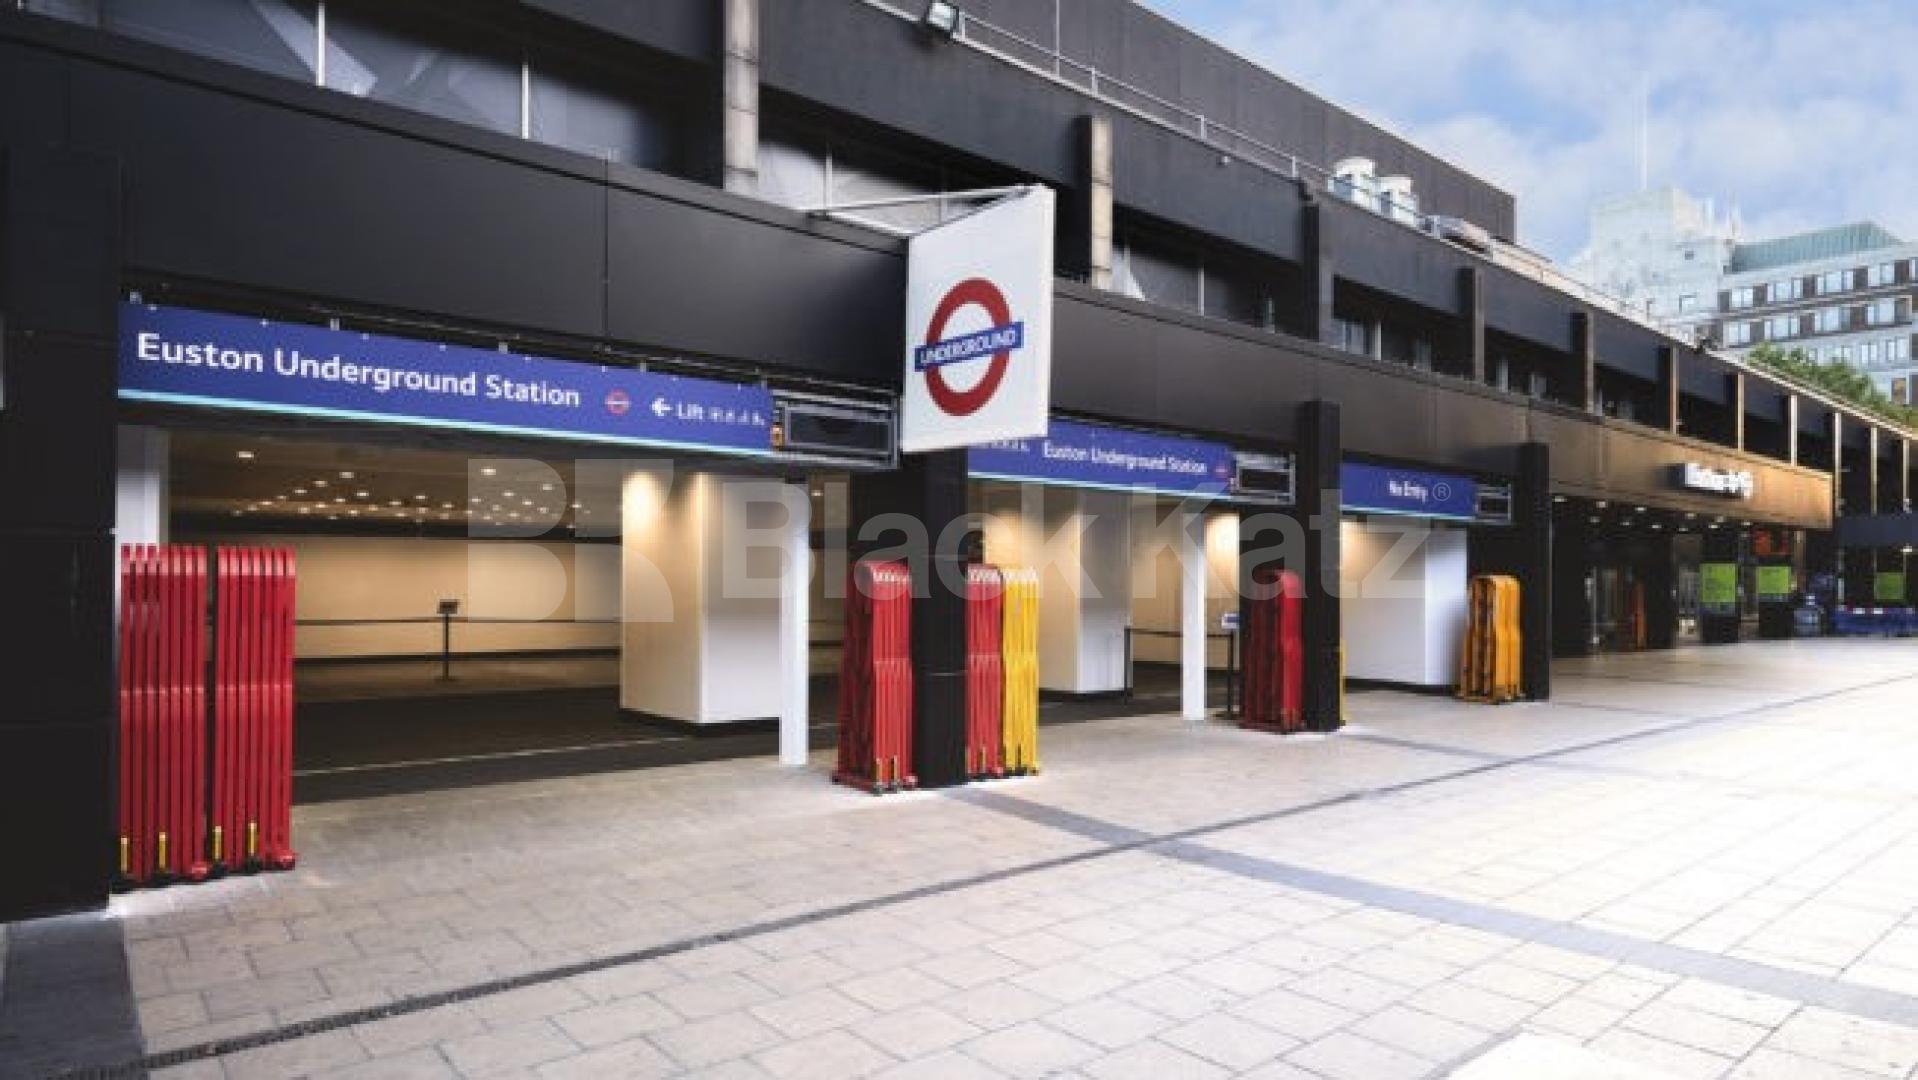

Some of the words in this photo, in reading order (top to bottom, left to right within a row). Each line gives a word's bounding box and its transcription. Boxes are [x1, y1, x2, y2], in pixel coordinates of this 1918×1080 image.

[920, 329, 1016, 364] UNDERGROUND
[137, 332, 264, 372] Euston
[273, 347, 476, 396] Underground
[485, 373, 581, 408] Station
[1044, 440, 1088, 462] Euston
[1091, 446, 1167, 471] Underground
[1168, 456, 1208, 474] Station
